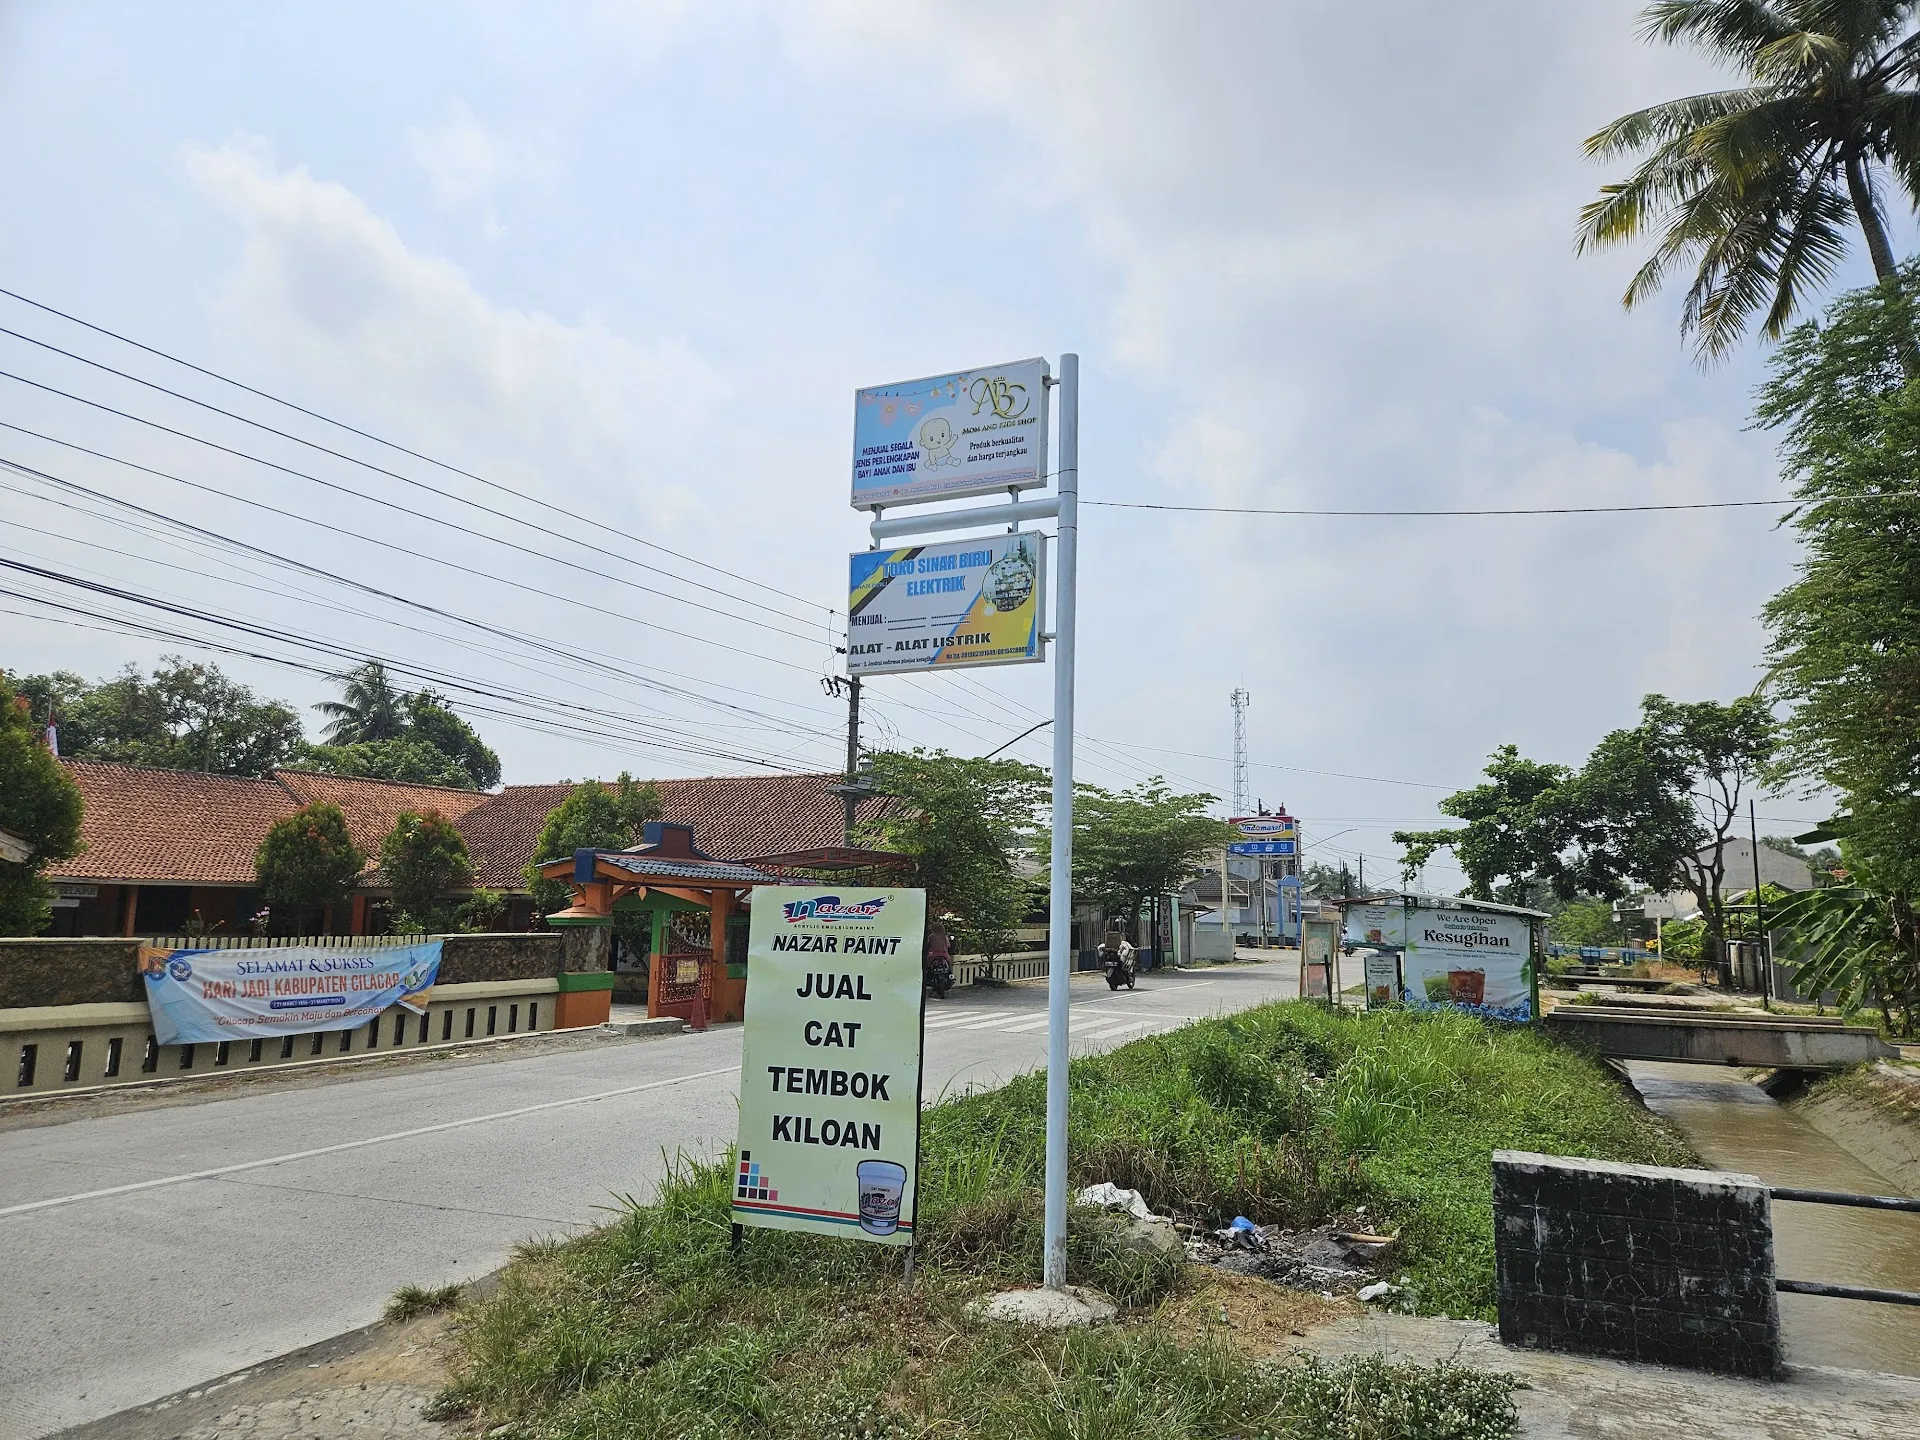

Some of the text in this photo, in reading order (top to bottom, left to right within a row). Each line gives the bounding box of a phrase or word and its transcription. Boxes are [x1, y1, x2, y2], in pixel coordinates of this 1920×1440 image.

[970, 377, 1030, 419] ABC
[962, 417, 1037, 435] MOM AND KIDS SHOP
[862, 441, 913, 456] MENJUAL SEGALA
[970, 436, 1024, 450] Produk berkualitas
[855, 451, 920, 468] JENIS PERLENGKAPAN
[967, 447, 1028, 462] dan harga terjangkau
[858, 463, 916, 479] BAYI ANAK DAN IBU
[883, 550, 992, 578] TOKO SINAR BIRU
[907, 575, 966, 597] ELEKTRIK
[851, 614, 883, 626] MENJUAL
[850, 642, 883, 655] ALAT
[895, 638, 930, 651] ALAT
[933, 633, 991, 648] LISTRIK
[1242, 823, 1281, 831] Indomaret
[1162, 901, 1170, 943] GYPSUM
[1453, 915, 1469, 923] Are
[1472, 916, 1496, 925] Open
[772, 934, 902, 955] NAZAR PAINT
[1424, 929, 1510, 948] Kesugihan
[237, 957, 374, 975] SELAMAT & SUKSES
[202, 973, 400, 999] HARI JADI KABUPATEN CILACAP
[796, 973, 872, 1000] JUAL
[1456, 990, 1476, 998] Desa
[257, 1013, 298, 1023] Semakin
[302, 1012, 323, 1022] Maju
[325, 1009, 341, 1018] dan
[804, 1020, 861, 1048] CAT
[768, 1066, 890, 1101] TEMBOK
[772, 1115, 881, 1150] KILOAN
